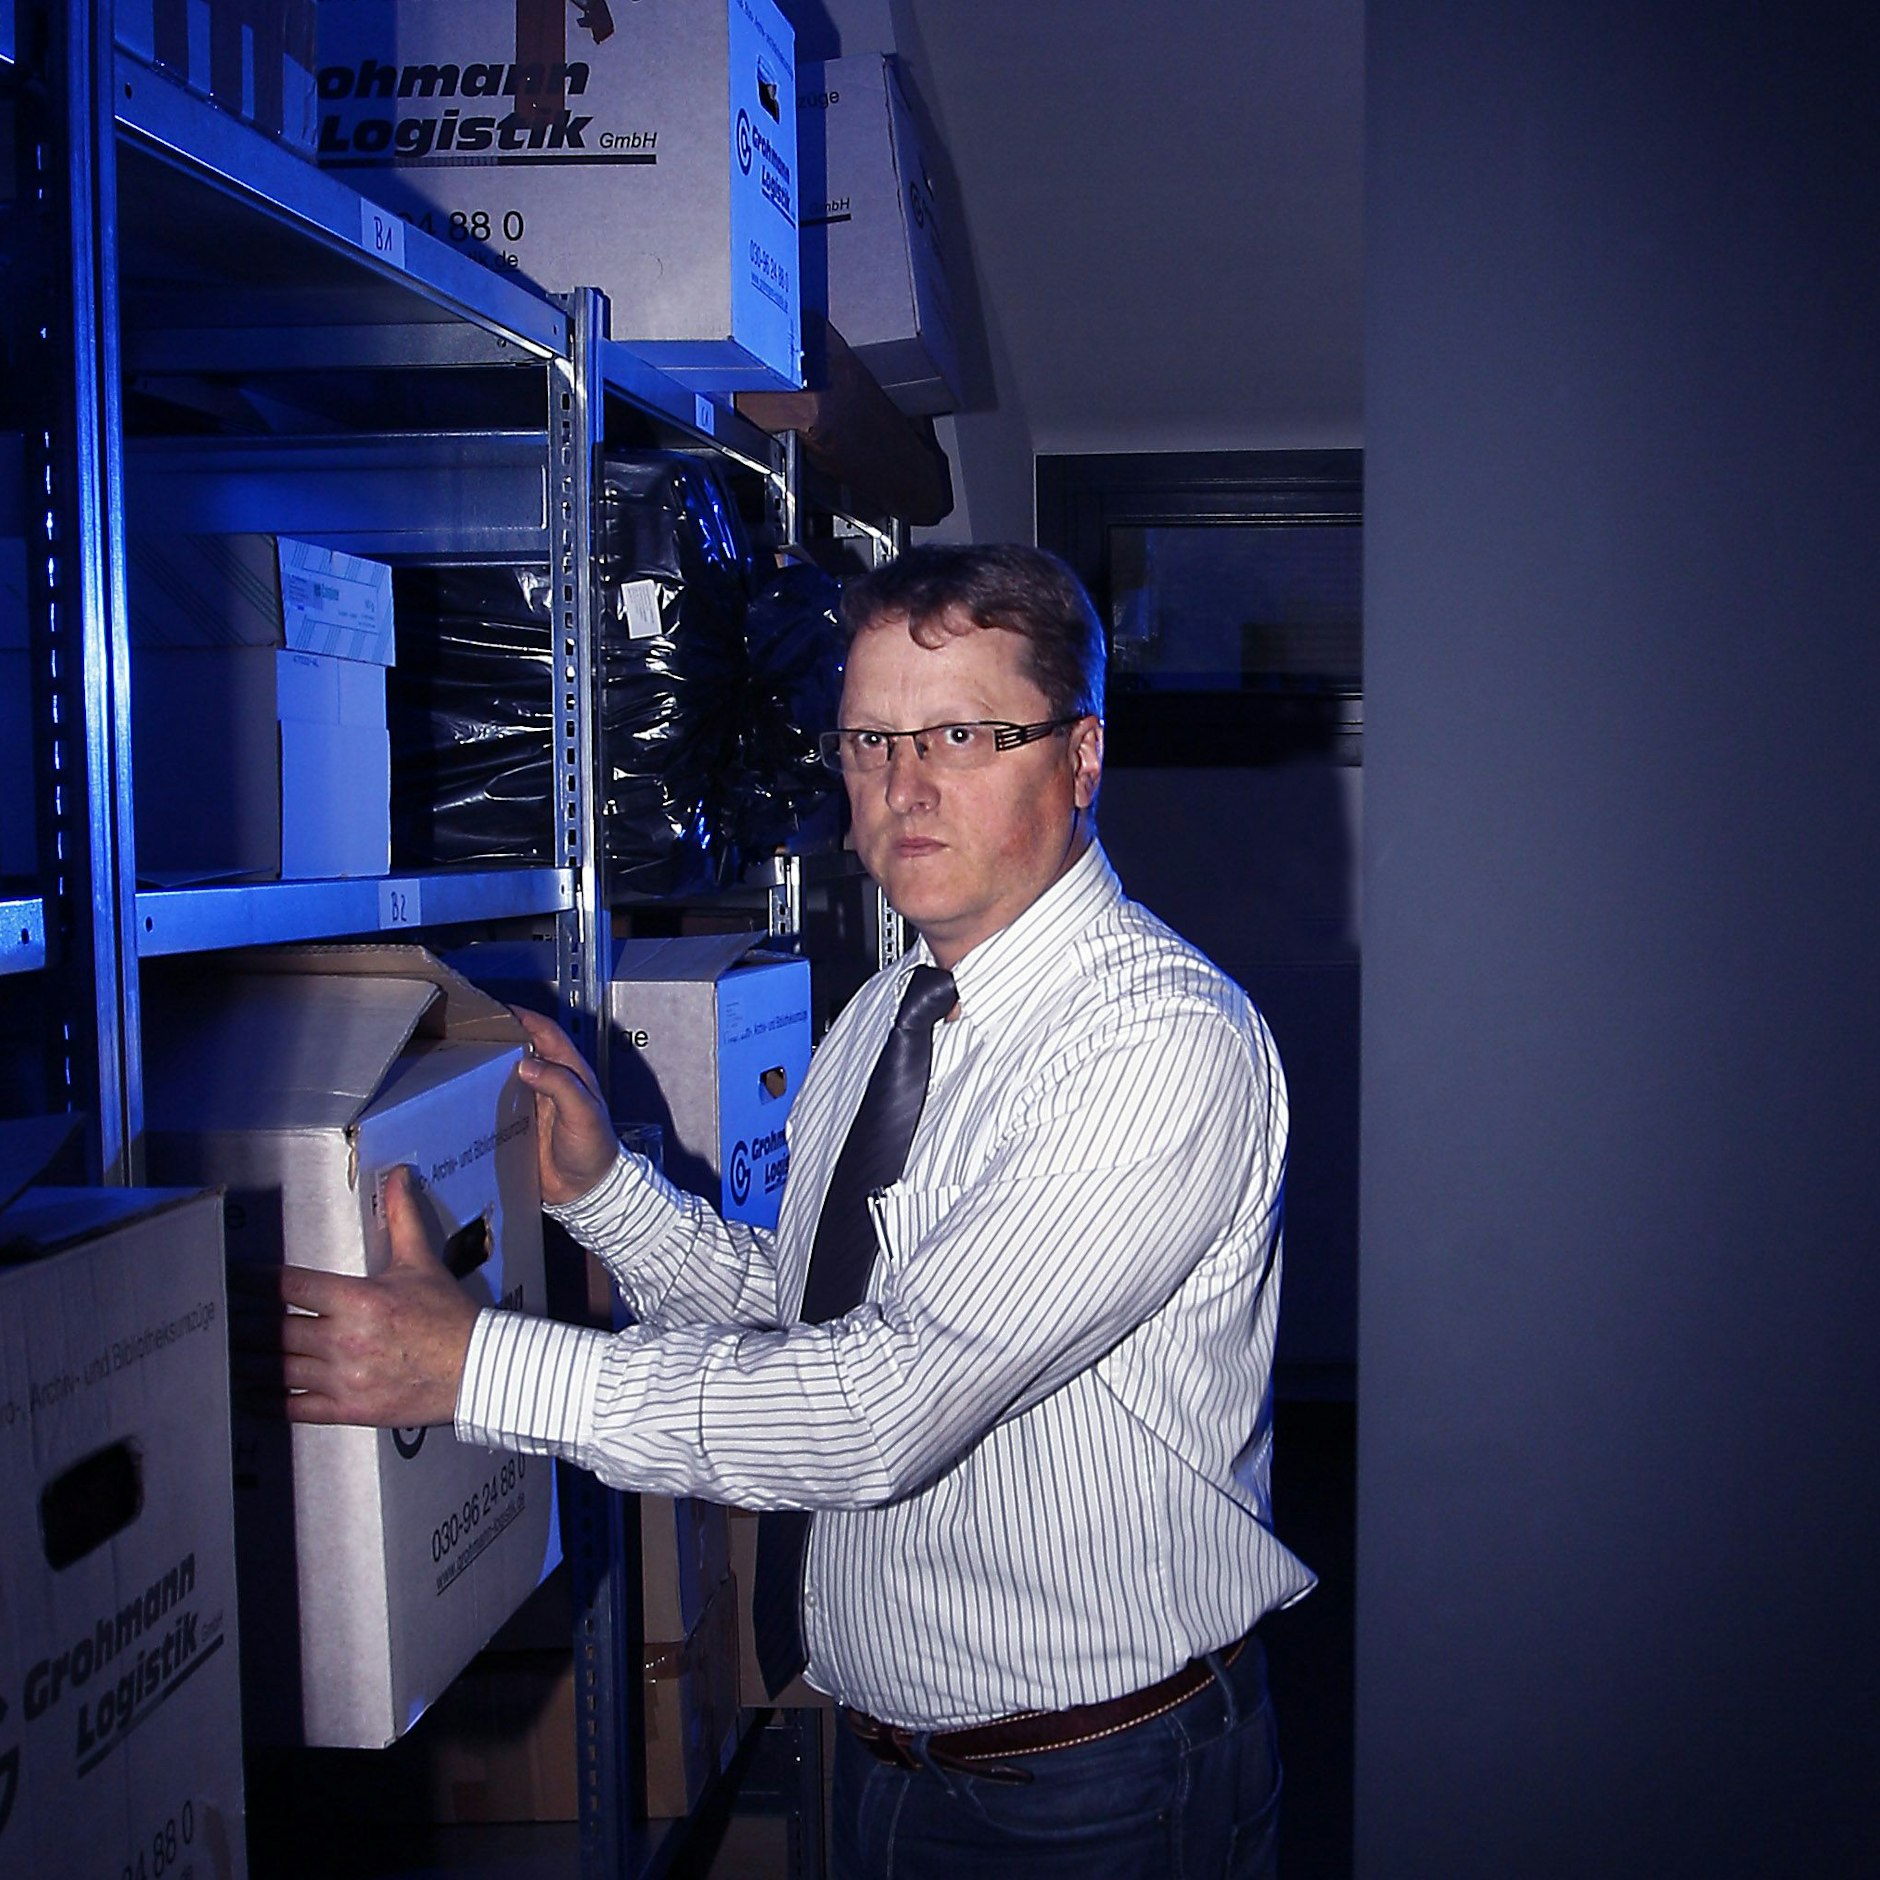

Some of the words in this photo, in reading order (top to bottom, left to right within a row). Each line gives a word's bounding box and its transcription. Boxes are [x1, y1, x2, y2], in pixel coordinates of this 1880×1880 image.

[317, 59, 591, 99] ohmann
[319, 109, 593, 157] Logistik
[599, 132, 657, 149] GmbH
[449, 210, 491, 242] 88
[503, 210, 524, 242] 0
[390, 891, 407, 923] B2
[752, 1129, 787, 1161] Grohm
[432, 1493, 480, 1563] 030-96
[482, 1476, 498, 1516] 24
[501, 1458, 516, 1496] 88
[24, 1553, 196, 1722] Grohmann
[77, 1612, 198, 1757] Logistik
[153, 1818, 177, 1879] 88
